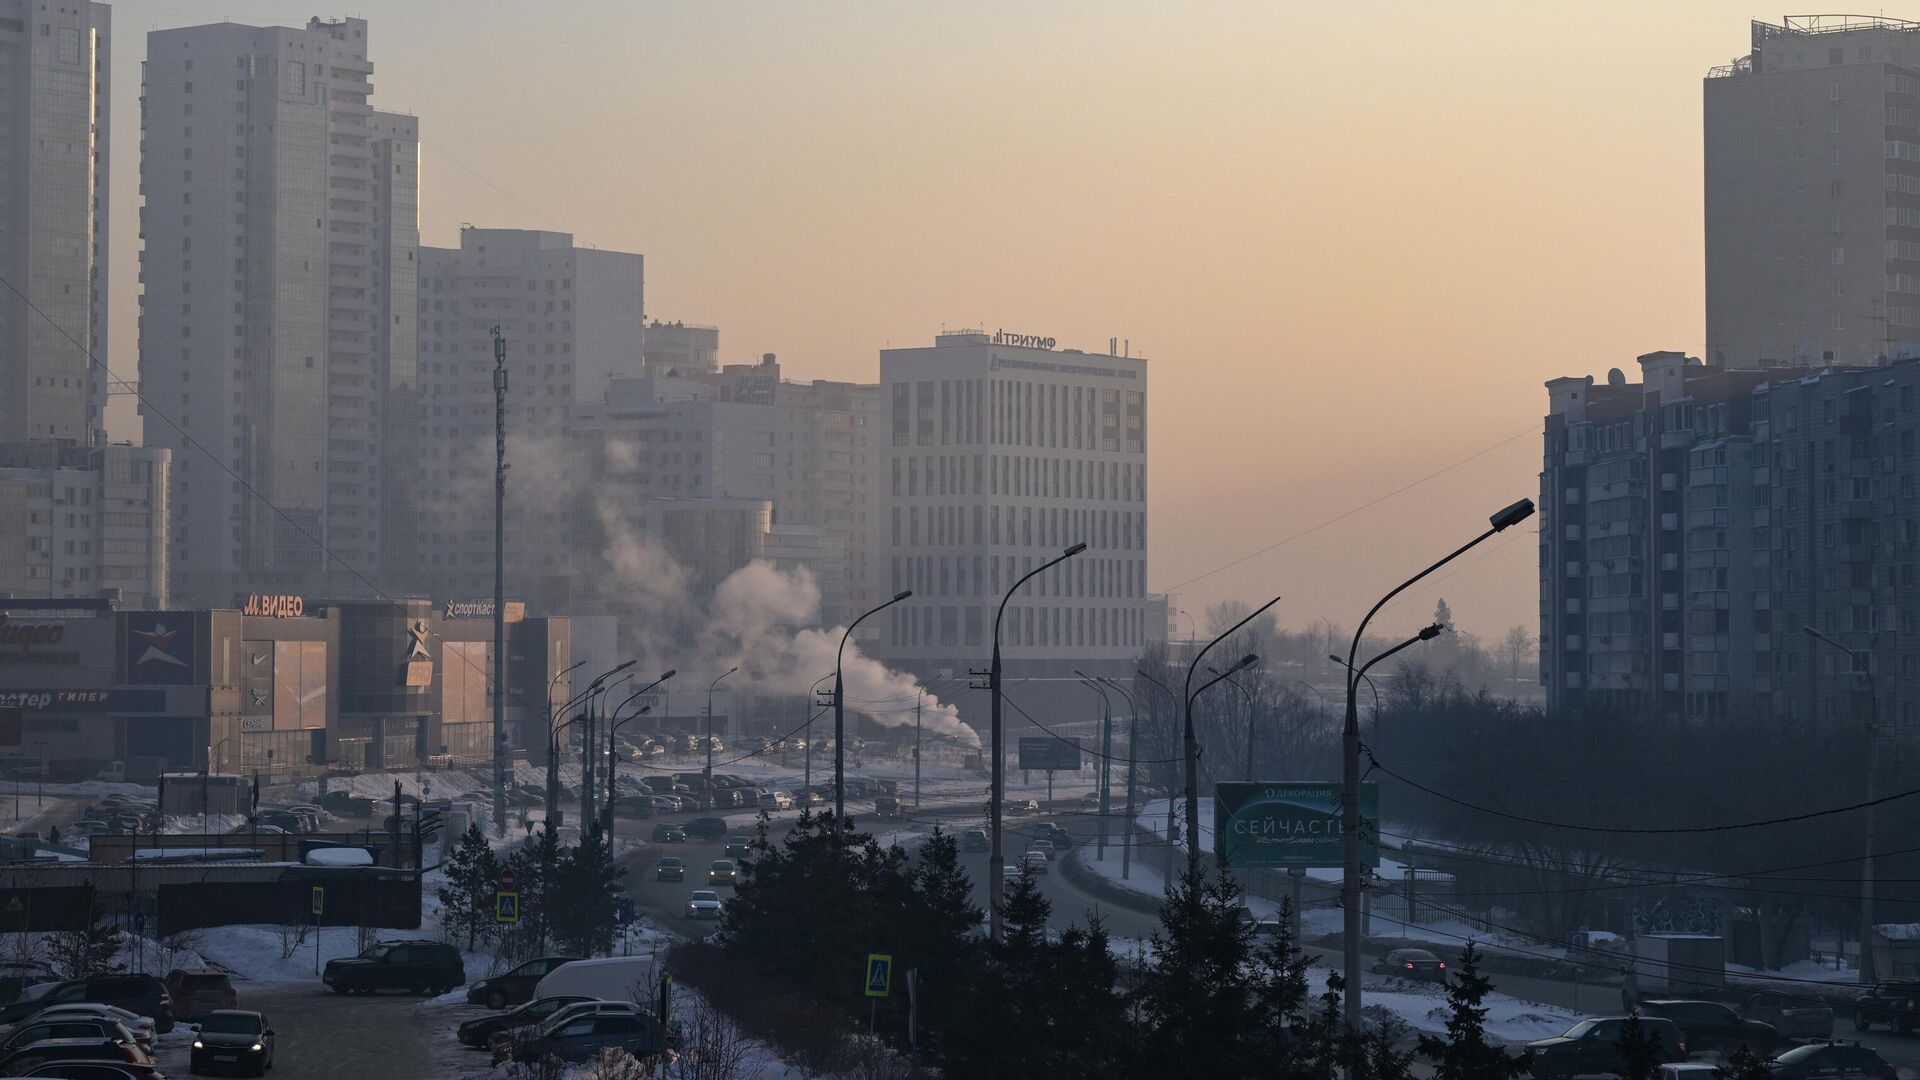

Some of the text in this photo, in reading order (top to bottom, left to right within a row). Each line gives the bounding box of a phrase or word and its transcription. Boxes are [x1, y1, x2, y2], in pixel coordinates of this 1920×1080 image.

[1003, 333, 1056, 348] ТРИУМФ
[244, 593, 303, 618] М.ВИДЕО
[57, 692, 109, 702] ГИПЕР
